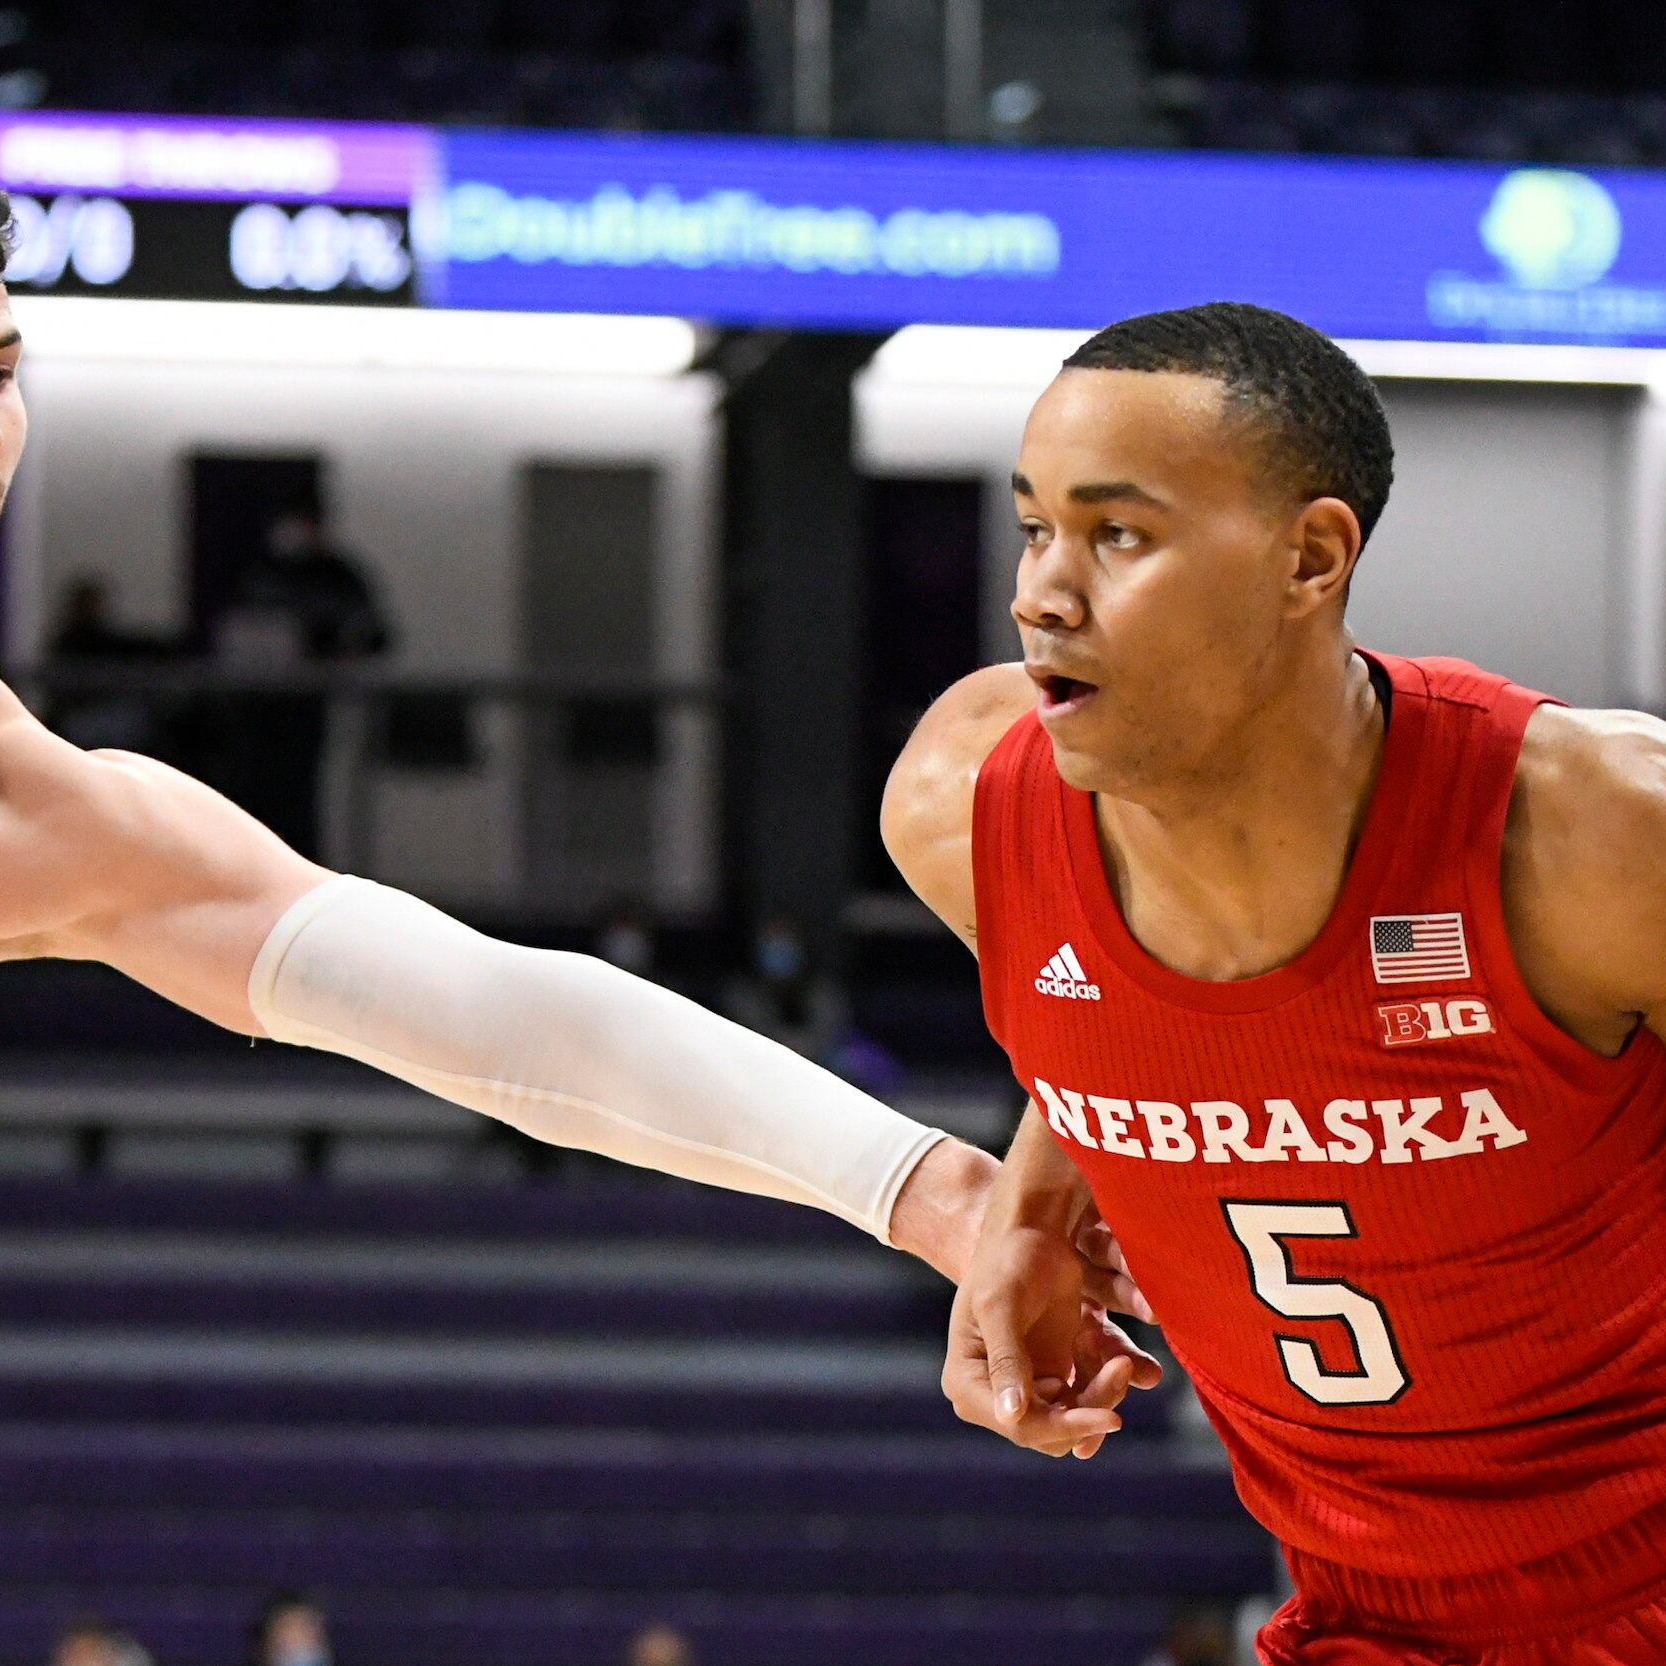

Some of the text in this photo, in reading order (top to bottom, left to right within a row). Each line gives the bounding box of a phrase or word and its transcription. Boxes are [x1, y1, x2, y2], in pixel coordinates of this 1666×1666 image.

[1034, 976, 1101, 1001] adidas
[1035, 1077, 1527, 1165] NEBRASKA
[1218, 1196, 1414, 1408] 5
